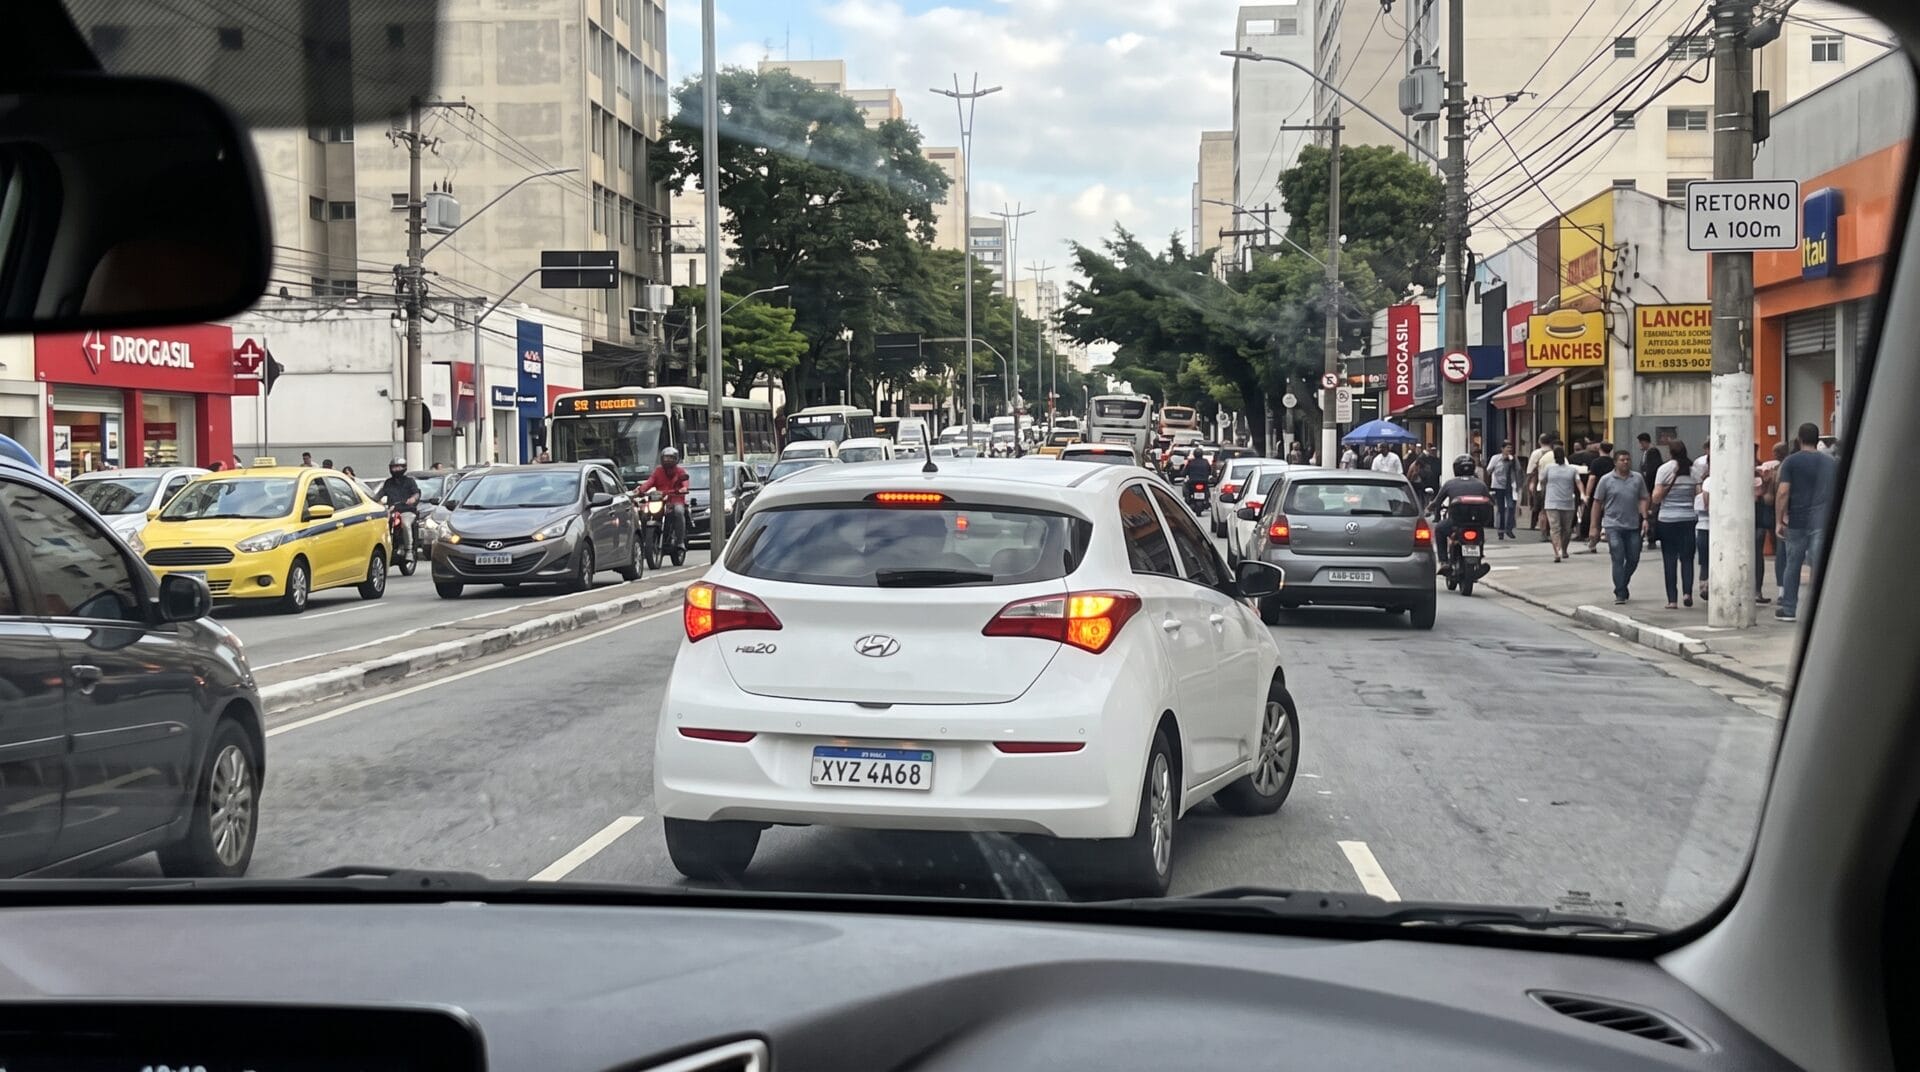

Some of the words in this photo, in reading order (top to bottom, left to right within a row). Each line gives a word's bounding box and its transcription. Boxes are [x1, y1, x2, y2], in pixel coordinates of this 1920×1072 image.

[1696, 193, 1790, 211] RETORNO
[1704, 222, 1718, 238] A
[1728, 221, 1781, 238] 100m
[1802, 232, 1828, 268] Itaú
[110, 335, 195, 369] DROGASIL
[1396, 319, 1409, 395] DROGASIL
[1530, 342, 1602, 361] LANCHES
[821, 760, 861, 782] XYZ
[867, 762, 921, 785] 4A68
